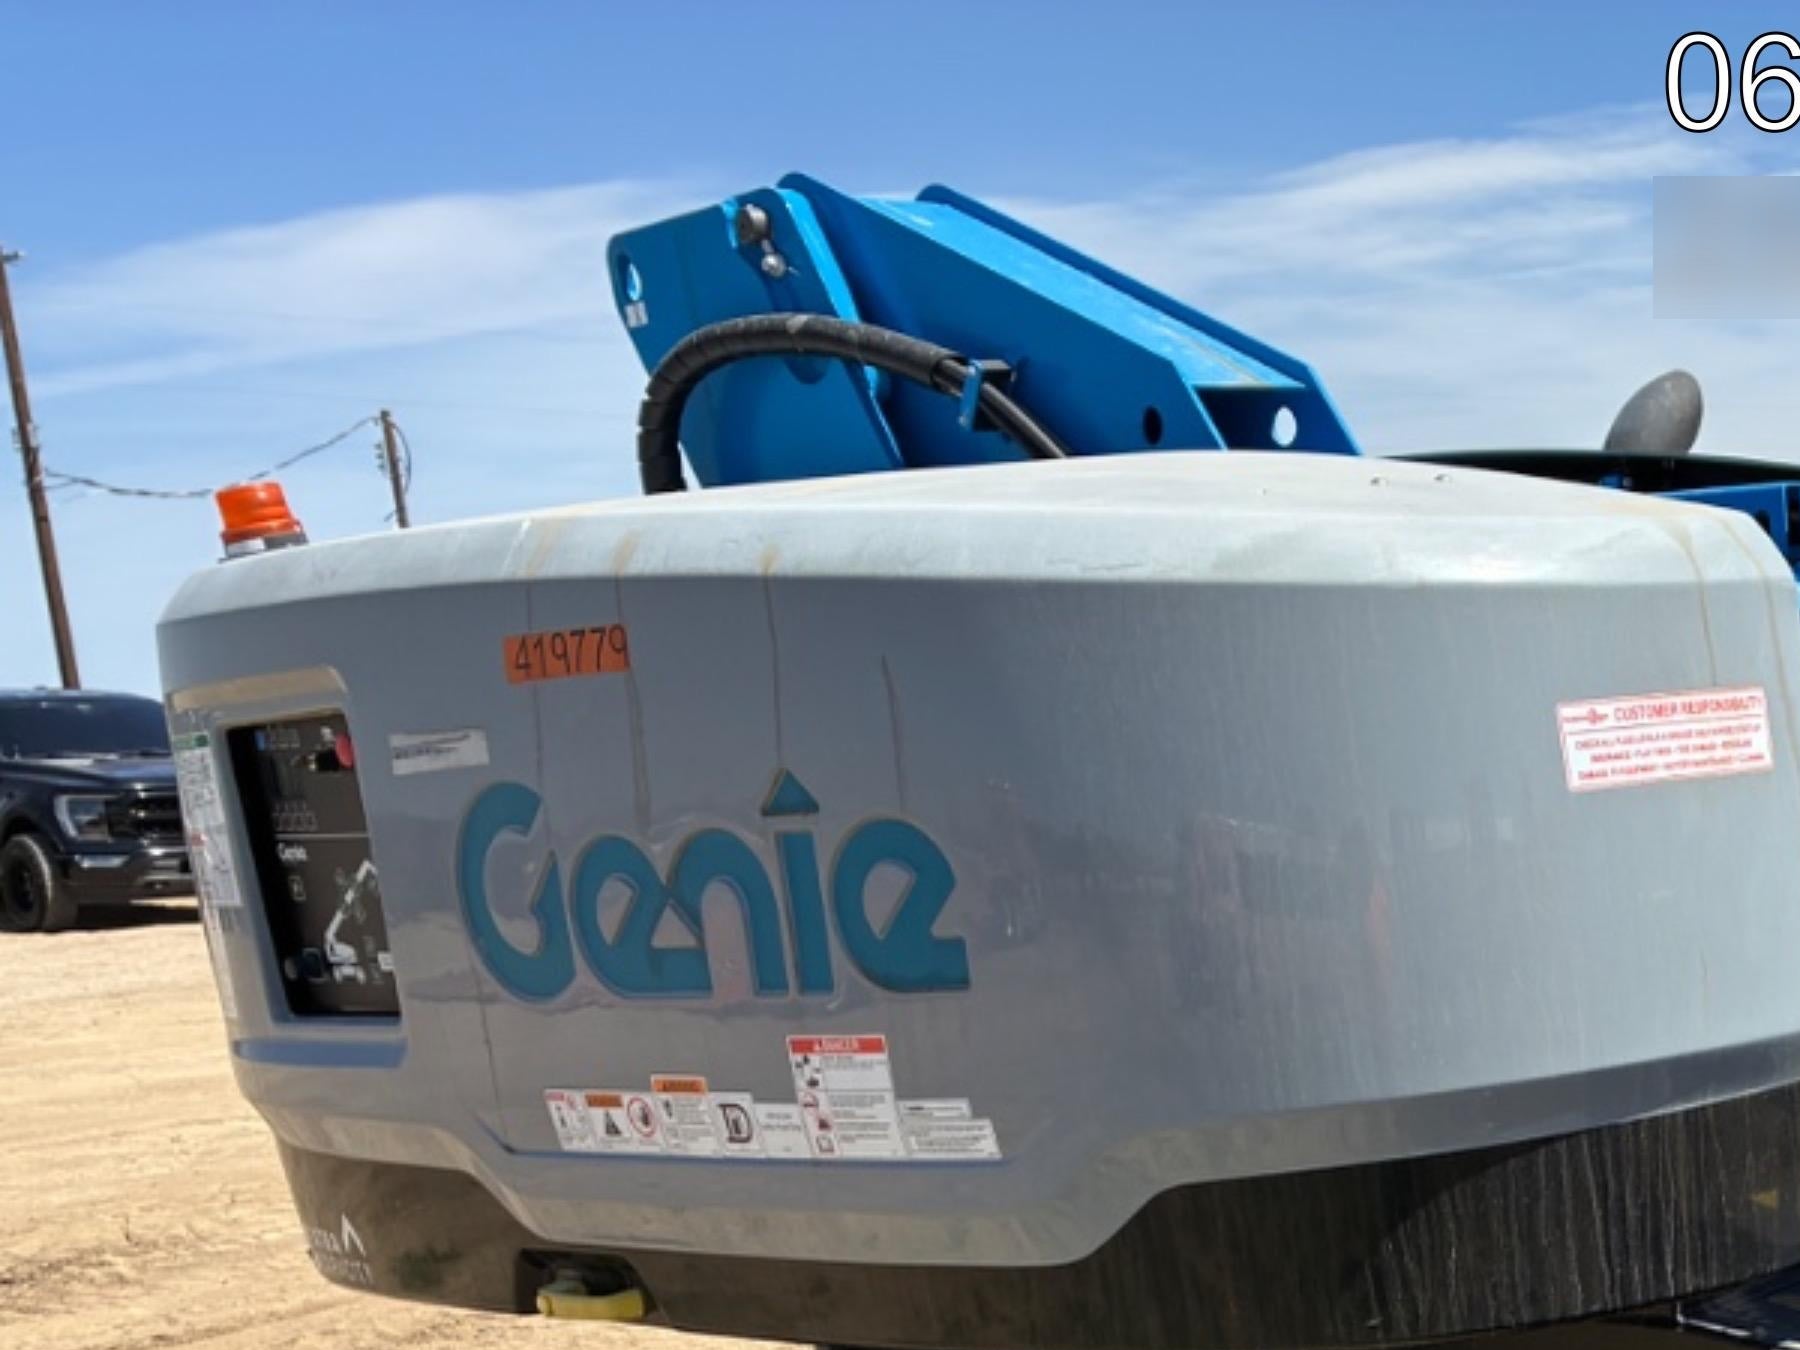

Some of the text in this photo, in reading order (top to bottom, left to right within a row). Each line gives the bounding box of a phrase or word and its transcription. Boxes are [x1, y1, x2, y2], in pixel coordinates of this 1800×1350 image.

[514, 623, 630, 679] 419779
[1613, 700, 1679, 722] CUSTOMER
[456, 768, 971, 1001] Genie
